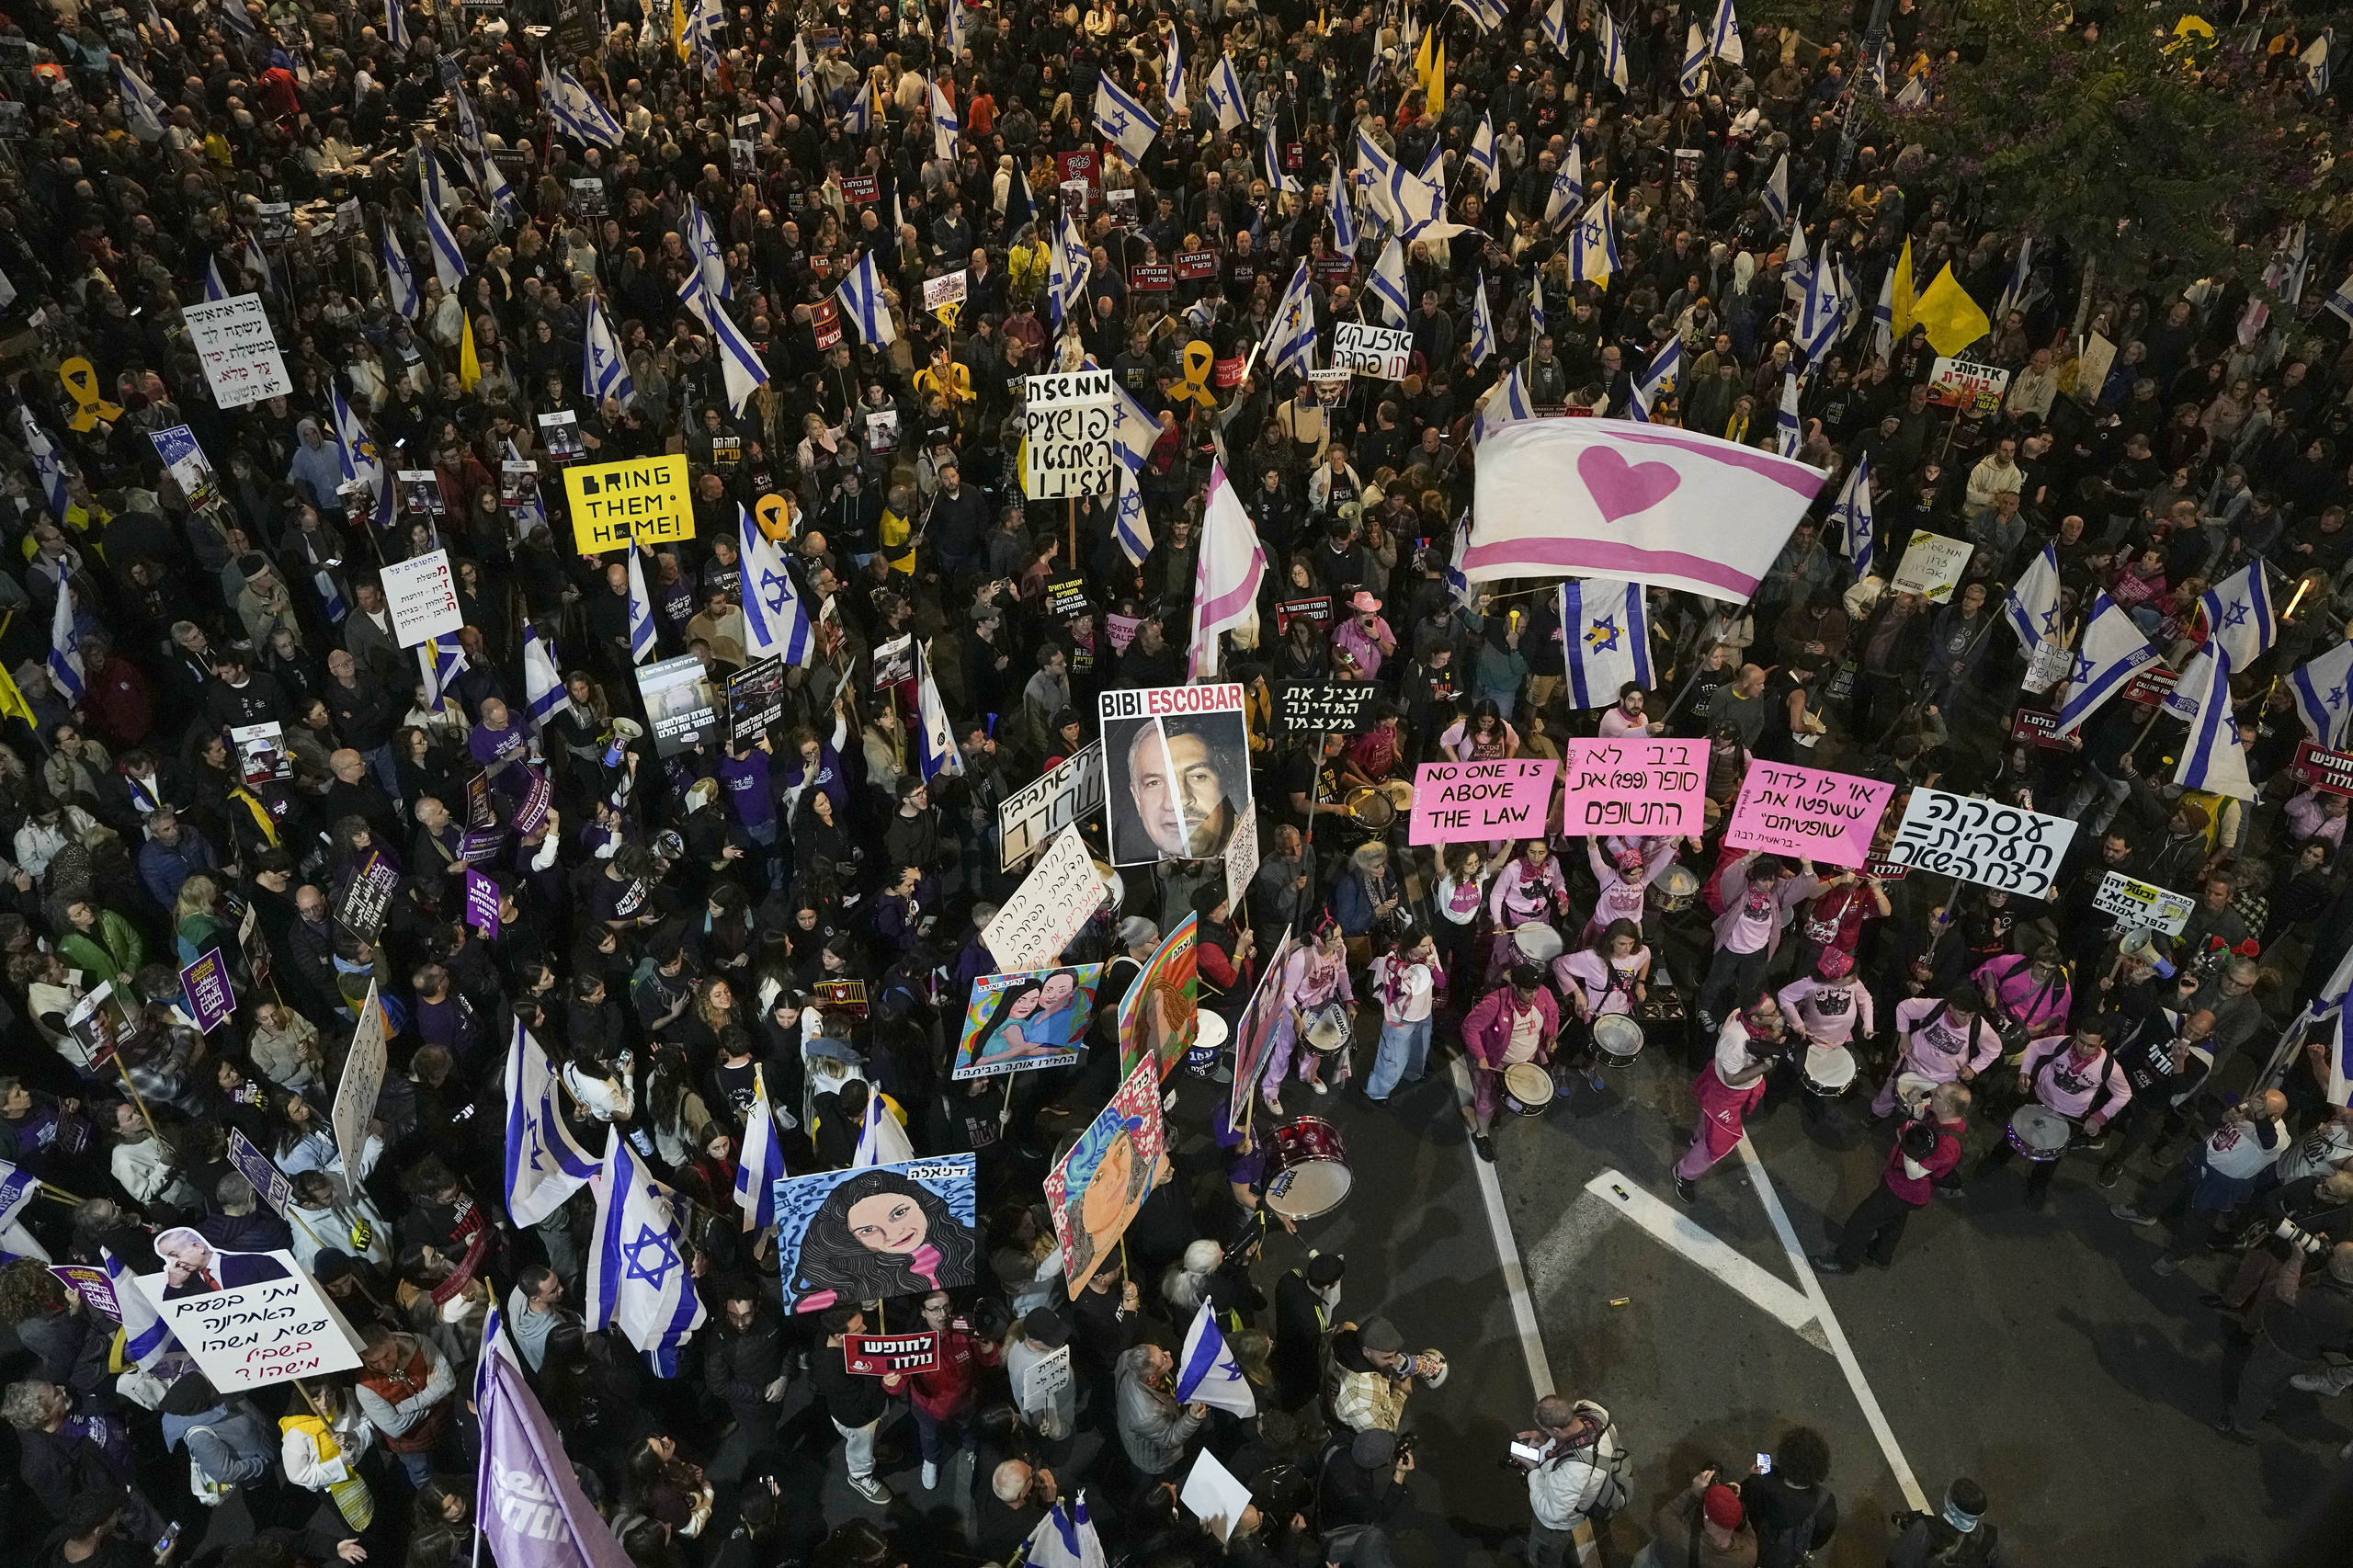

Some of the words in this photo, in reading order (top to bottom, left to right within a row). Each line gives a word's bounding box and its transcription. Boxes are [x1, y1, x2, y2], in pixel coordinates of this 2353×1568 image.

[854, 187, 874, 196] עכשיו
[1189, 261, 1212, 270] עכשיו
[1331, 350, 1381, 377] פקודה!
[1388, 356, 1406, 380] תן
[1027, 374, 1109, 403] ממשלת
[1186, 381, 1202, 393] NOW.
[1028, 407, 1108, 441] פושעים
[153, 427, 188, 442] בחירות
[713, 437, 723, 449] הם
[724, 437, 740, 449] למה
[713, 449, 740, 461] עדיין
[1033, 440, 1112, 471] השתלטו
[582, 466, 671, 496] BRING
[1040, 469, 1112, 497] עלינו
[1334, 489, 1353, 500] FCK
[389, 566, 401, 575] על
[404, 555, 439, 572] החטופים
[1048, 582, 1065, 593] רואים
[1056, 587, 1078, 598] חטופים
[1056, 597, 1074, 606] רואים
[1056, 600, 1087, 614] התנחלויות
[2037, 642, 2071, 662] LIVES
[2048, 656, 2066, 675] lies
[2140, 672, 2152, 680] OUR
[1282, 687, 1315, 700] את
[1323, 685, 1376, 701] תציל
[2136, 681, 2160, 692] CALLING
[764, 702, 781, 718] אחרת
[1101, 692, 1142, 716] BIBI
[1148, 685, 1243, 715] ESCOBAR
[1286, 700, 1359, 714] המדינה
[655, 712, 690, 731] המלחמה
[691, 707, 714, 720] אחרת
[691, 715, 716, 728] תגמור
[735, 713, 764, 733] המלחמה
[763, 710, 781, 725] תגמור
[1283, 716, 1356, 730] מעצמך
[658, 725, 677, 739] כולנו
[678, 721, 690, 733] את
[735, 722, 753, 740] כולנו
[753, 718, 763, 730] את
[1586, 744, 1623, 764] לא
[1426, 767, 1458, 783] NO
[1465, 764, 1508, 781] ONE
[1518, 763, 1543, 778] IS
[1571, 771, 1608, 793] את
[1653, 770, 1699, 792] סופר
[1760, 768, 1806, 791] לדור
[1439, 782, 1514, 803] ABOVE
[1816, 776, 1836, 795] לו
[1753, 789, 1790, 808] את
[1795, 794, 1865, 819] ששפטו
[1006, 769, 1102, 848] שחרר
[1427, 809, 1471, 828] THE
[1483, 804, 1530, 826] LAW
[1585, 801, 1683, 826] החטופים
[1927, 794, 2054, 843] עסקה
[1733, 829, 1754, 840] רבה
[1927, 829, 2054, 869] חלקית
[356, 873, 364, 884] די
[476, 878, 493, 894] לא
[1983, 862, 2049, 894] רצח
[344, 881, 362, 915] למלחמה
[470, 887, 497, 907] למלחמת
[2102, 888, 2149, 913] רמאי
[362, 901, 375, 922] STOP
[369, 909, 381, 927] THE
[375, 893, 387, 912] WAR
[476, 904, 493, 920] בעזה
[2094, 897, 2137, 920] אמונים
[2143, 915, 2169, 931] מפר
[1173, 936, 1193, 960] נעמה
[195, 974, 219, 996] מצילים
[200, 990, 224, 1016] חיים
[1331, 1011, 1349, 1036] מחאה
[1005, 1060, 1034, 1071] אותה
[1039, 1055, 1074, 1066] החזירו
[1134, 1069, 1149, 1091] לירי
[911, 1166, 966, 1178] דניאלה
[1276, 1170, 1298, 1199] Legend
[263, 1283, 300, 1303] מתי
[176, 1295, 245, 1318] בפעם
[202, 1306, 296, 1333] האחרונה
[271, 1318, 332, 1343] עשית
[200, 1333, 258, 1354] משהו
[245, 1341, 313, 1364] בשביל
[864, 1336, 933, 1354] לחופש
[234, 1357, 321, 1381] מישהו?
[893, 1353, 933, 1369] נולדו
[1038, 1350, 1067, 1373] אחרת
[1036, 1377, 1047, 1386] לי
[1051, 1365, 1067, 1380] אין
[1045, 1377, 1067, 1395] ארץ
